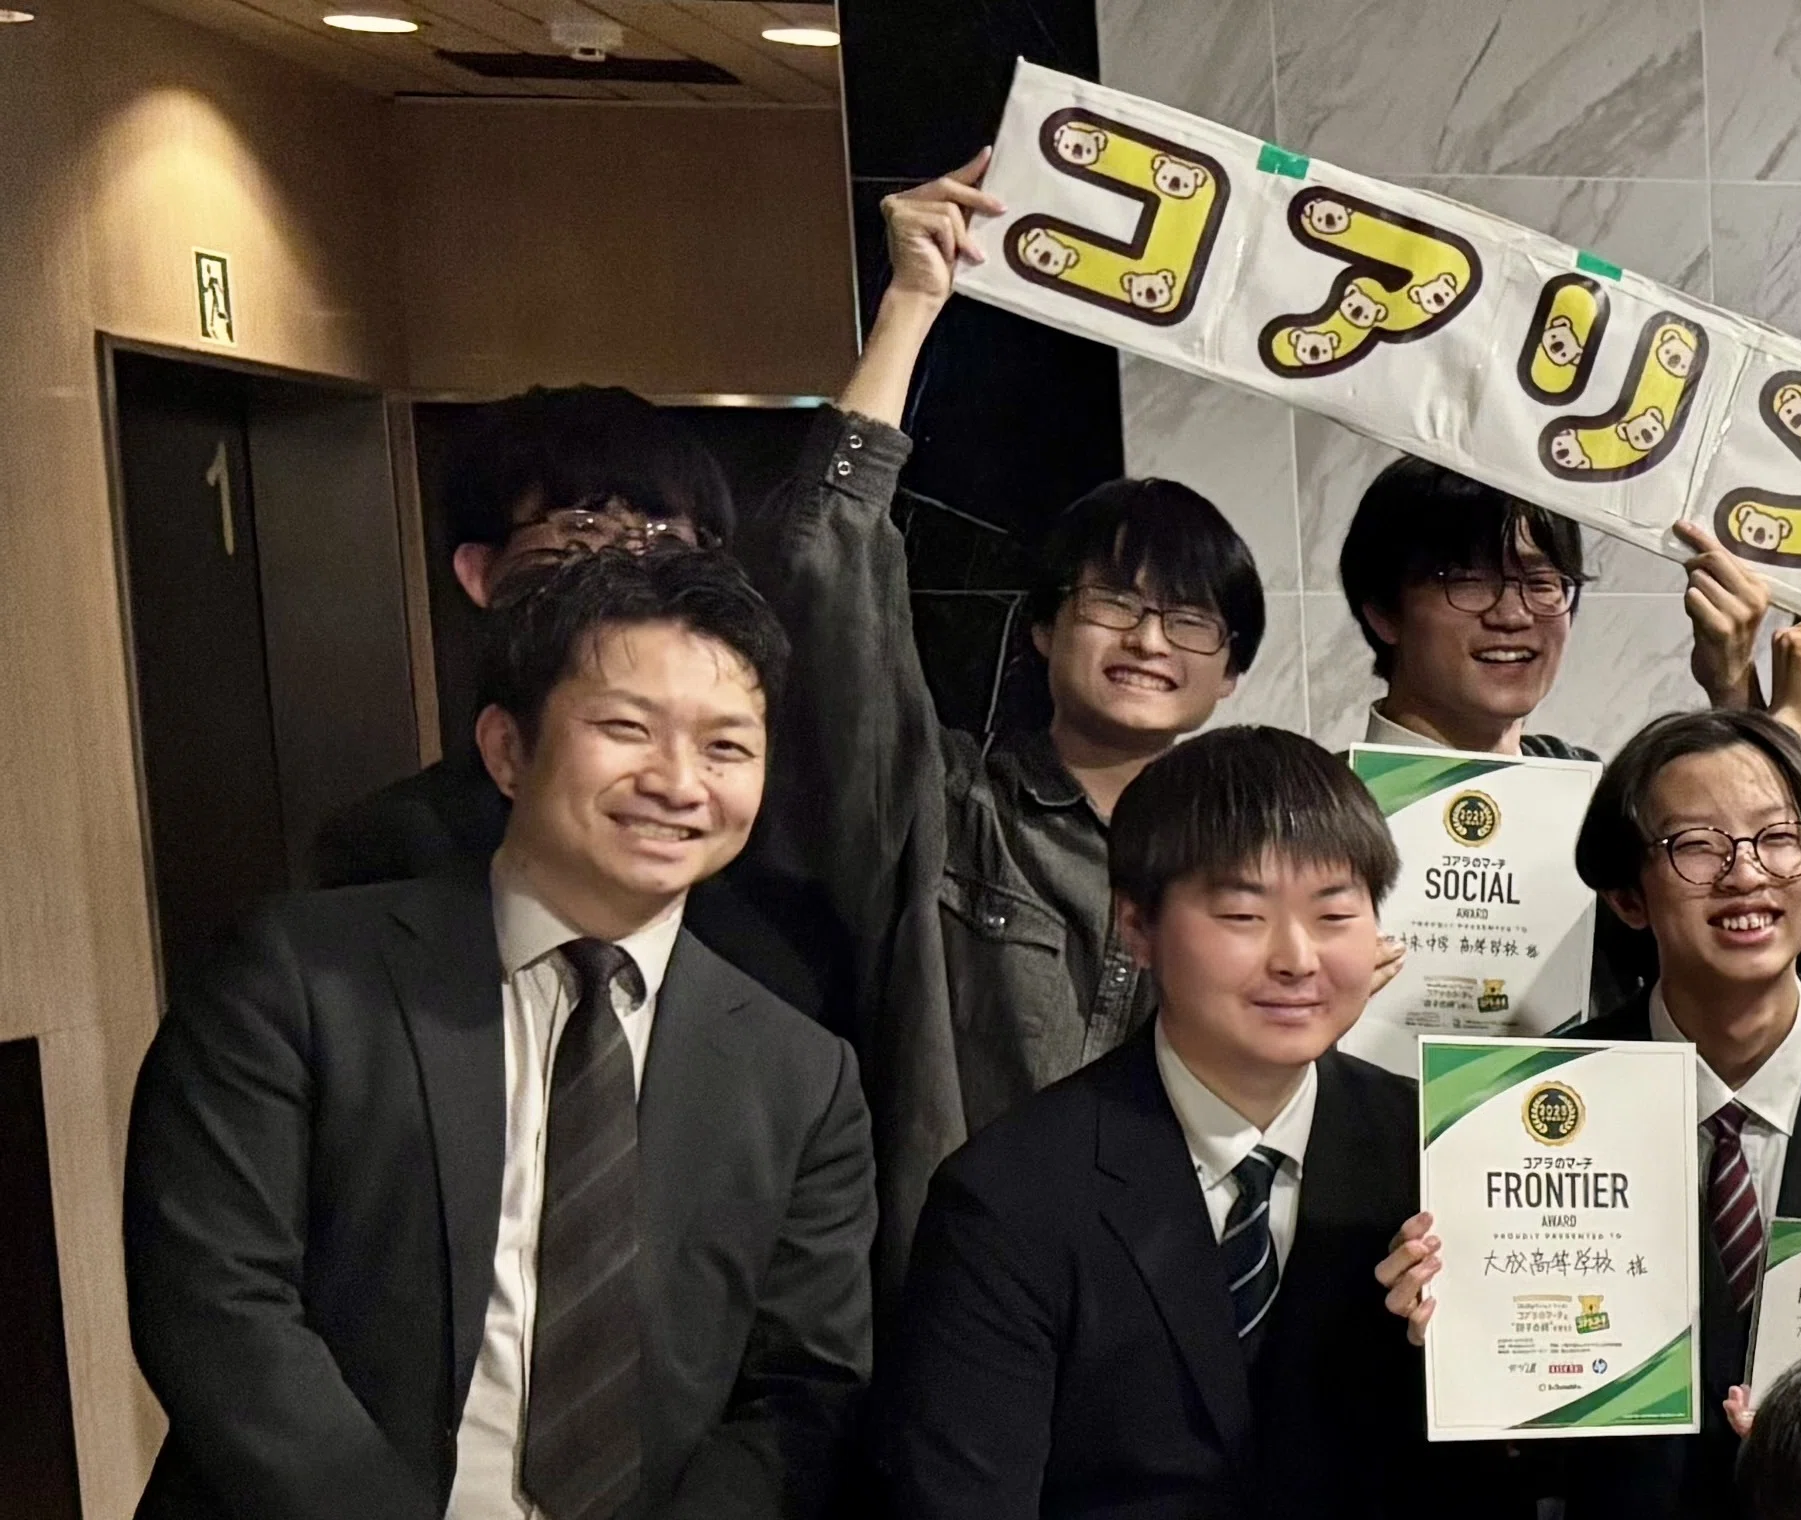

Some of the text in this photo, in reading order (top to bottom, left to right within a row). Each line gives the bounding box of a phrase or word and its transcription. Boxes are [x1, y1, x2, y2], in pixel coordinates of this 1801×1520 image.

[206, 441, 234, 556] 1
[1425, 868, 1521, 905] SOCIAL
[1523, 1157, 1593, 1170] コアラのマーチ
[1486, 1171, 1629, 1209] FRONTIER
[1541, 1215, 1577, 1228] AWARD
